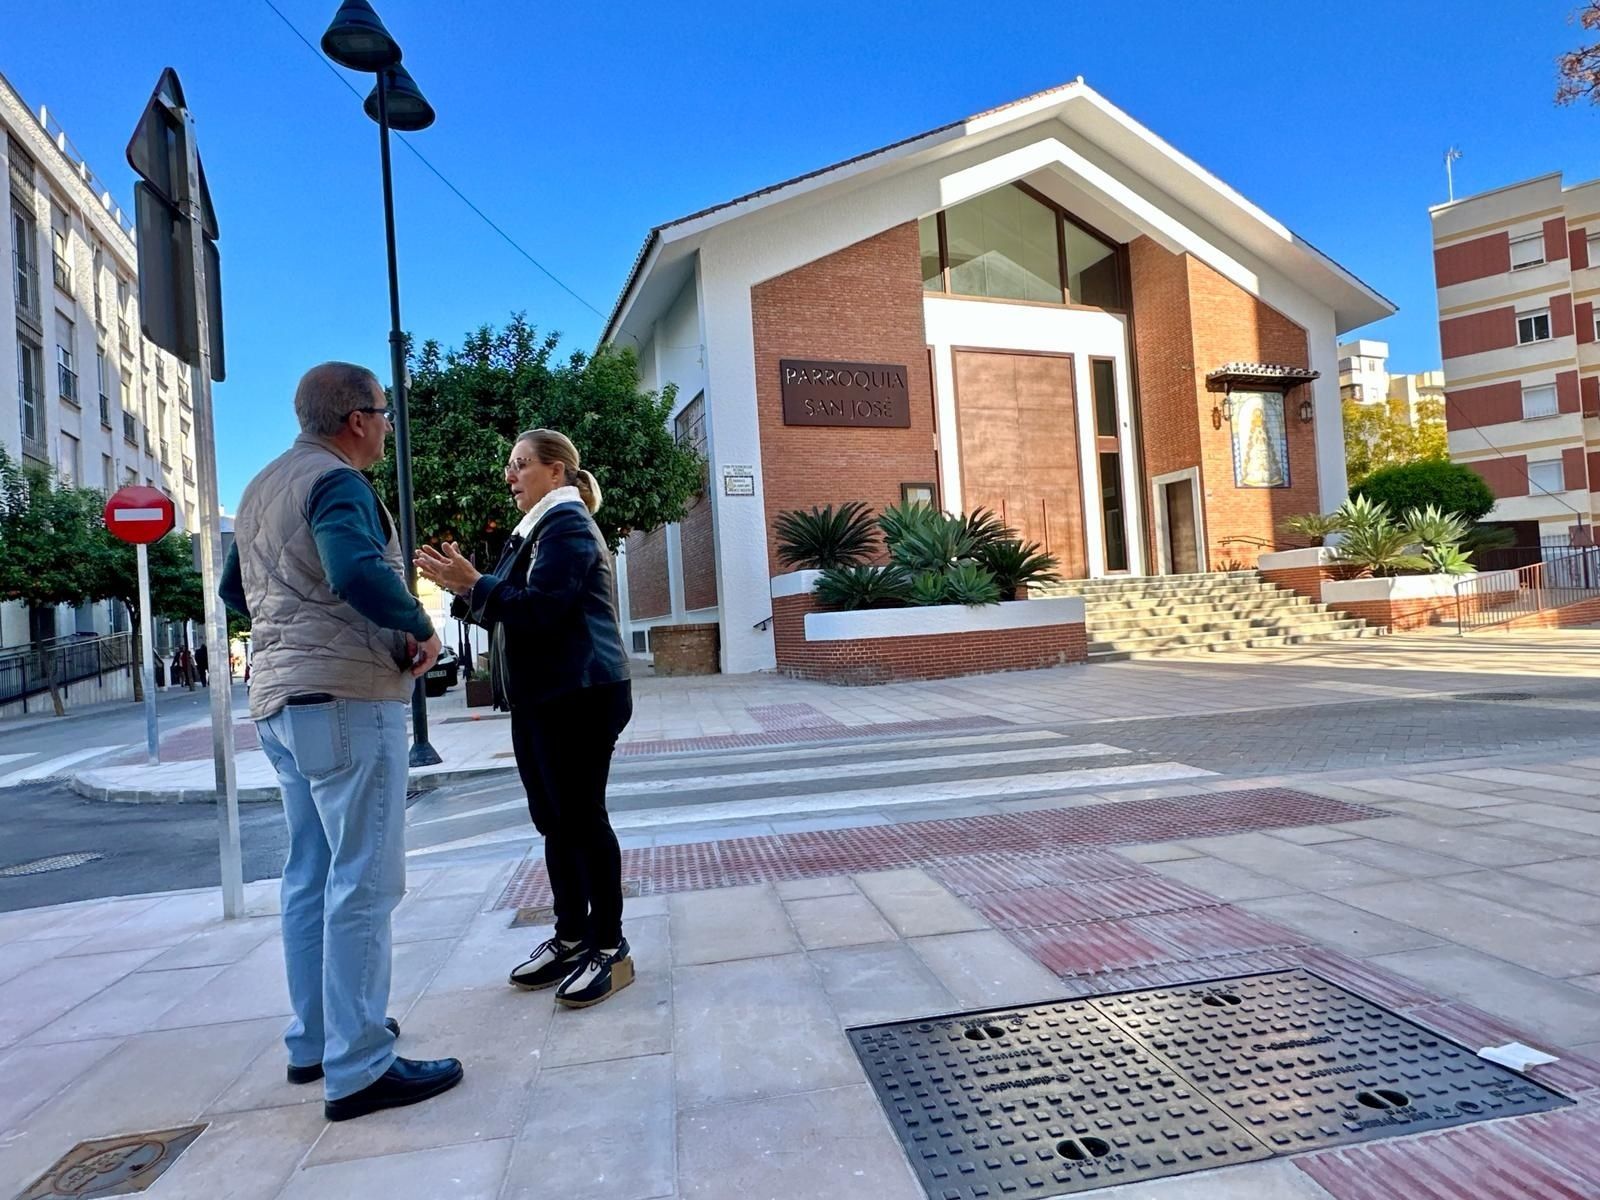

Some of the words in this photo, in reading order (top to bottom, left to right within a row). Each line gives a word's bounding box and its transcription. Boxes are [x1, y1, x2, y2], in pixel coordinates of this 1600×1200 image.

[786, 367, 904, 391] PARROQUIA
[804, 398, 845, 417] SAN
[850, 397, 893, 420] JOSÉ
